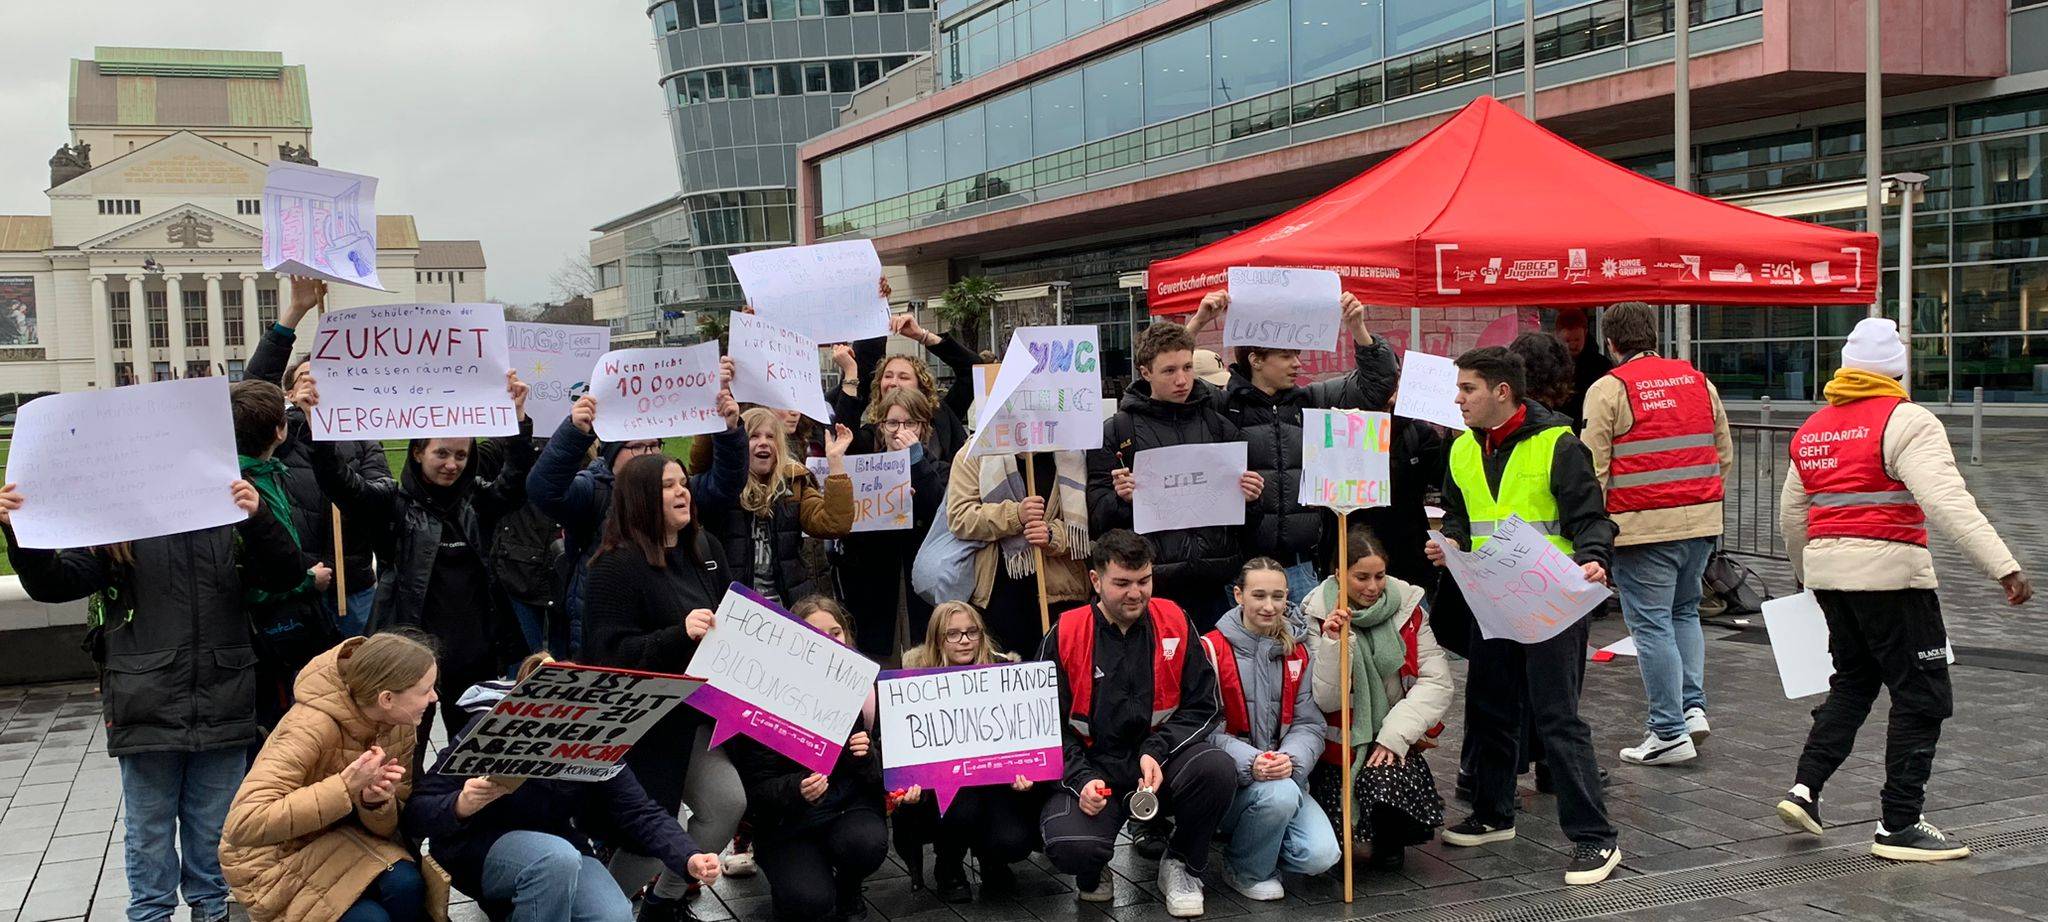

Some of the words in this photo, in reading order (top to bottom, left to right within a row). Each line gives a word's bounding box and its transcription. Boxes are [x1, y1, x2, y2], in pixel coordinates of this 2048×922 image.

[1618, 259, 1642, 268] JUNGE
[1618, 267, 1647, 276] GRUPPE
[1761, 264, 1792, 278] EVG
[1360, 267, 1400, 278] BEWEGUNG
[1505, 269, 1548, 280] Jugend
[1158, 274, 1206, 295] Gewerkschaft
[1206, 268, 1228, 286] mach
[326, 312, 358, 324] Keine
[460, 308, 473, 316] der
[316, 326, 489, 361] ZUKUNFT
[327, 368, 339, 378] in
[606, 362, 645, 376] Wenn
[374, 384, 398, 396] aus
[410, 385, 433, 395] der
[1636, 374, 1695, 390] SOLIDARITÄT
[1640, 390, 1666, 400] GEHT
[1642, 400, 1676, 412] IMMER!
[316, 406, 512, 434] VERGANGENHEIT
[1800, 426, 1870, 444] SOLIDARITÄT
[1799, 445, 1830, 458] GEHT
[855, 455, 906, 474] Bildung
[1800, 458, 1838, 470] IMMER!
[861, 476, 883, 492] ich
[1498, 542, 1531, 570] DIE
[725, 600, 785, 646] HOCH
[788, 632, 822, 666] DIE
[1918, 648, 1938, 660] BLACK
[531, 667, 584, 685] ES
[590, 673, 654, 691] IST
[888, 676, 952, 707] HOCH
[962, 670, 989, 696] DIE
[1000, 666, 1058, 693] HÄNDE
[511, 682, 680, 710] SCHLECHT
[494, 700, 598, 721] NICHT
[597, 706, 649, 724] ZU
[906, 697, 1058, 748] BILDUNGSWENDE
[455, 737, 552, 756] ABER
